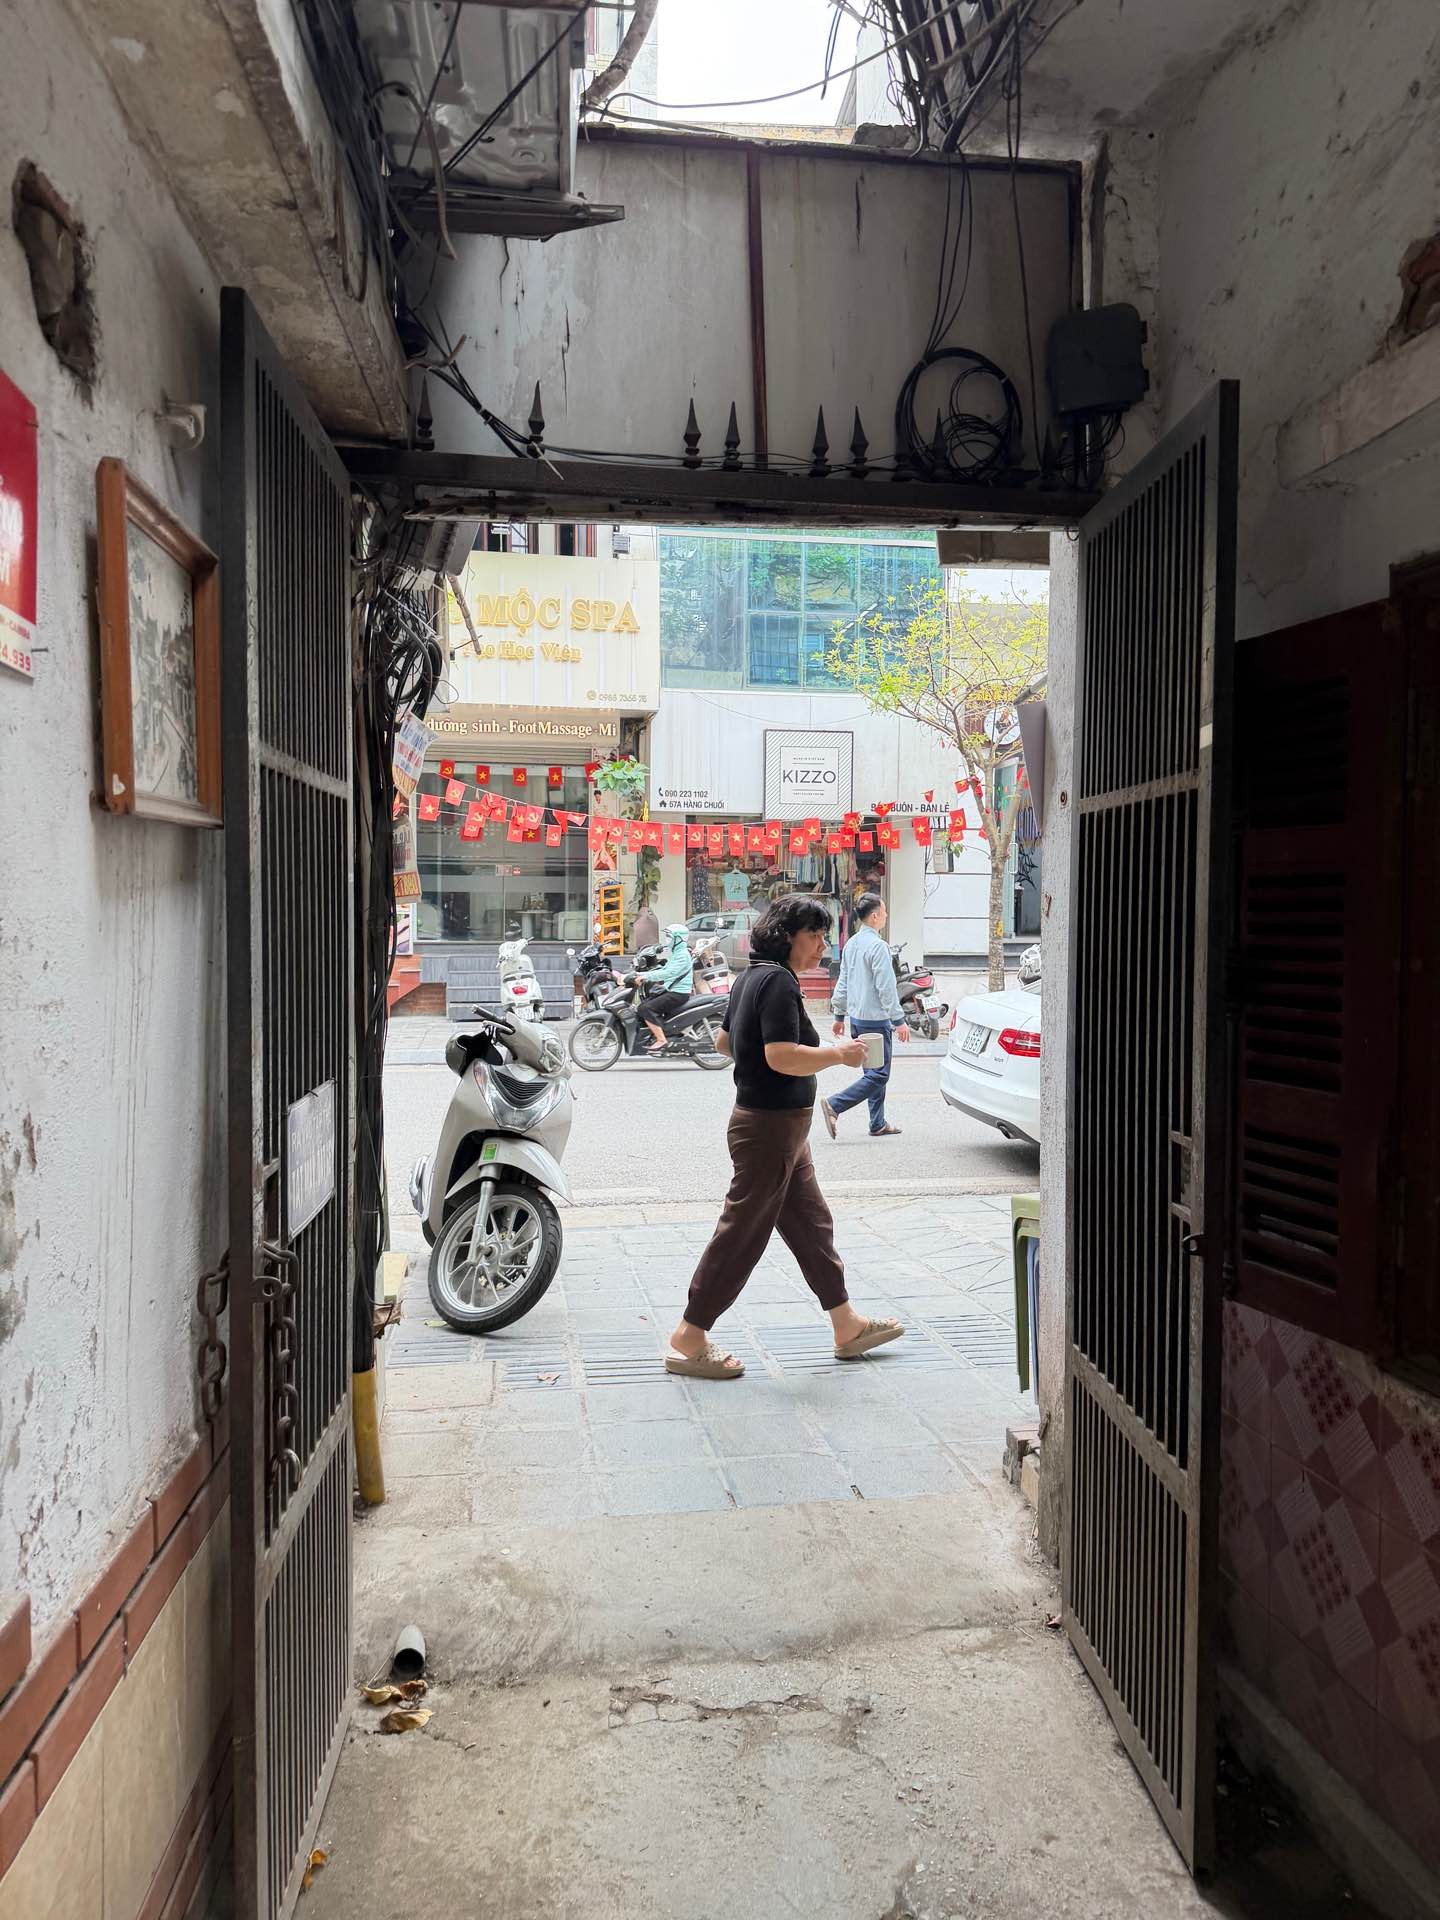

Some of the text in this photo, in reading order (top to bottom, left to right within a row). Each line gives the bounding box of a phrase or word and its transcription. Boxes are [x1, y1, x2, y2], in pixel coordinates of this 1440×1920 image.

[478, 586, 561, 637] MỘC
[571, 598, 640, 633] SPA
[499, 640, 534, 664] Học
[472, 719, 500, 733] sinh
[782, 769, 836, 783] KIZZO
[664, 790, 708, 798] 090 223 1102
[669, 800, 682, 809] 57A
[683, 799, 702, 809] HÀNG
